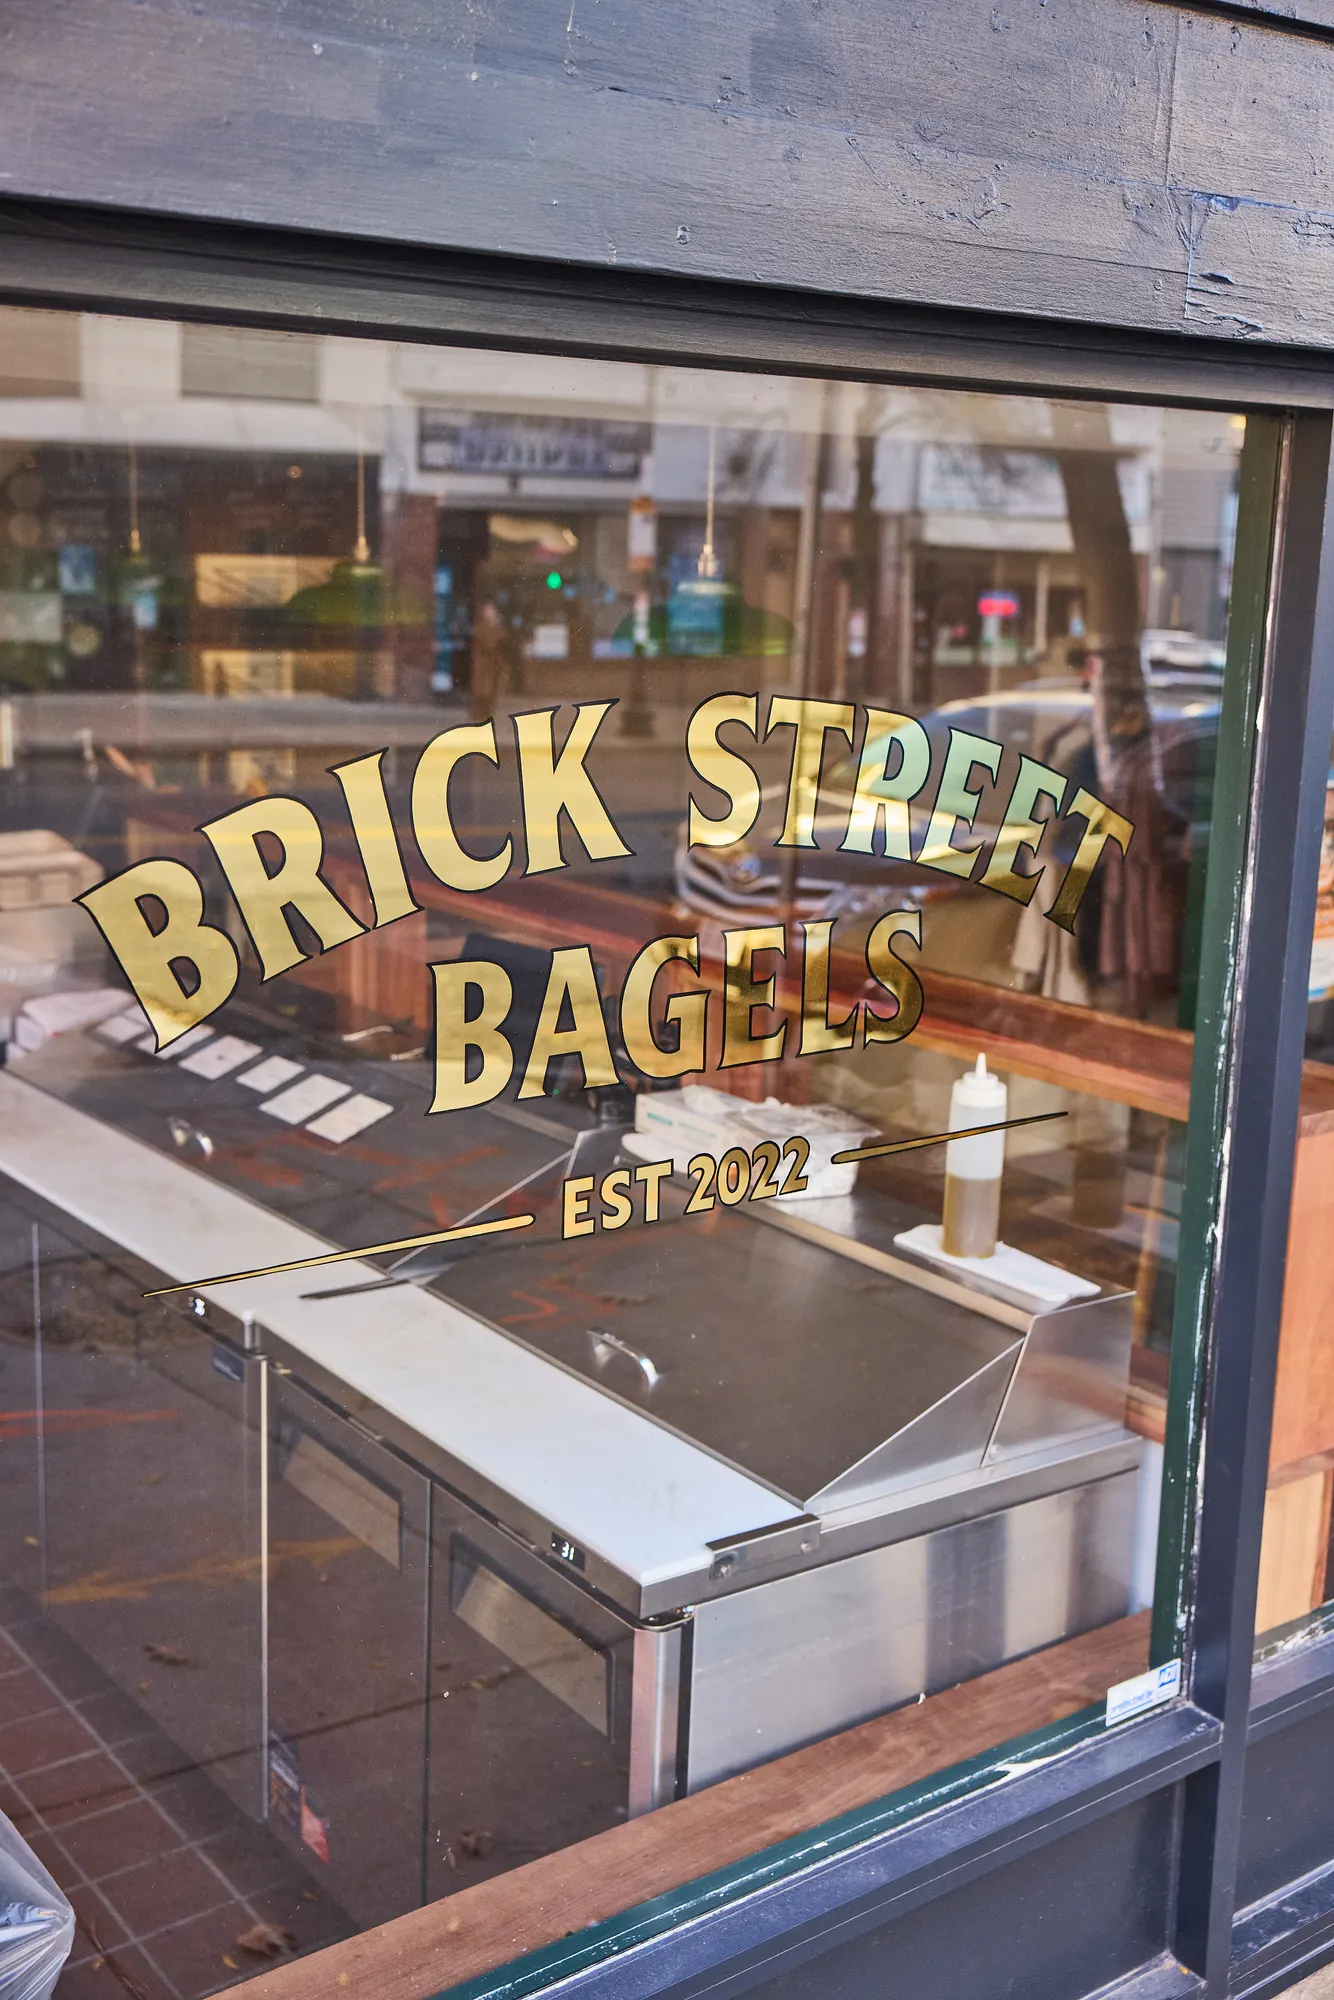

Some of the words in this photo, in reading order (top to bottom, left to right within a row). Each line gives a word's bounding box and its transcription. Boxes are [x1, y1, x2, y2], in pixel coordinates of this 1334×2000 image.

[72, 698, 637, 1053] BRICK
[685, 691, 1136, 936] STREET
[425, 909, 924, 1116] BAGELS
[562, 1159, 674, 1240] EST
[683, 1136, 811, 1215] 2022
